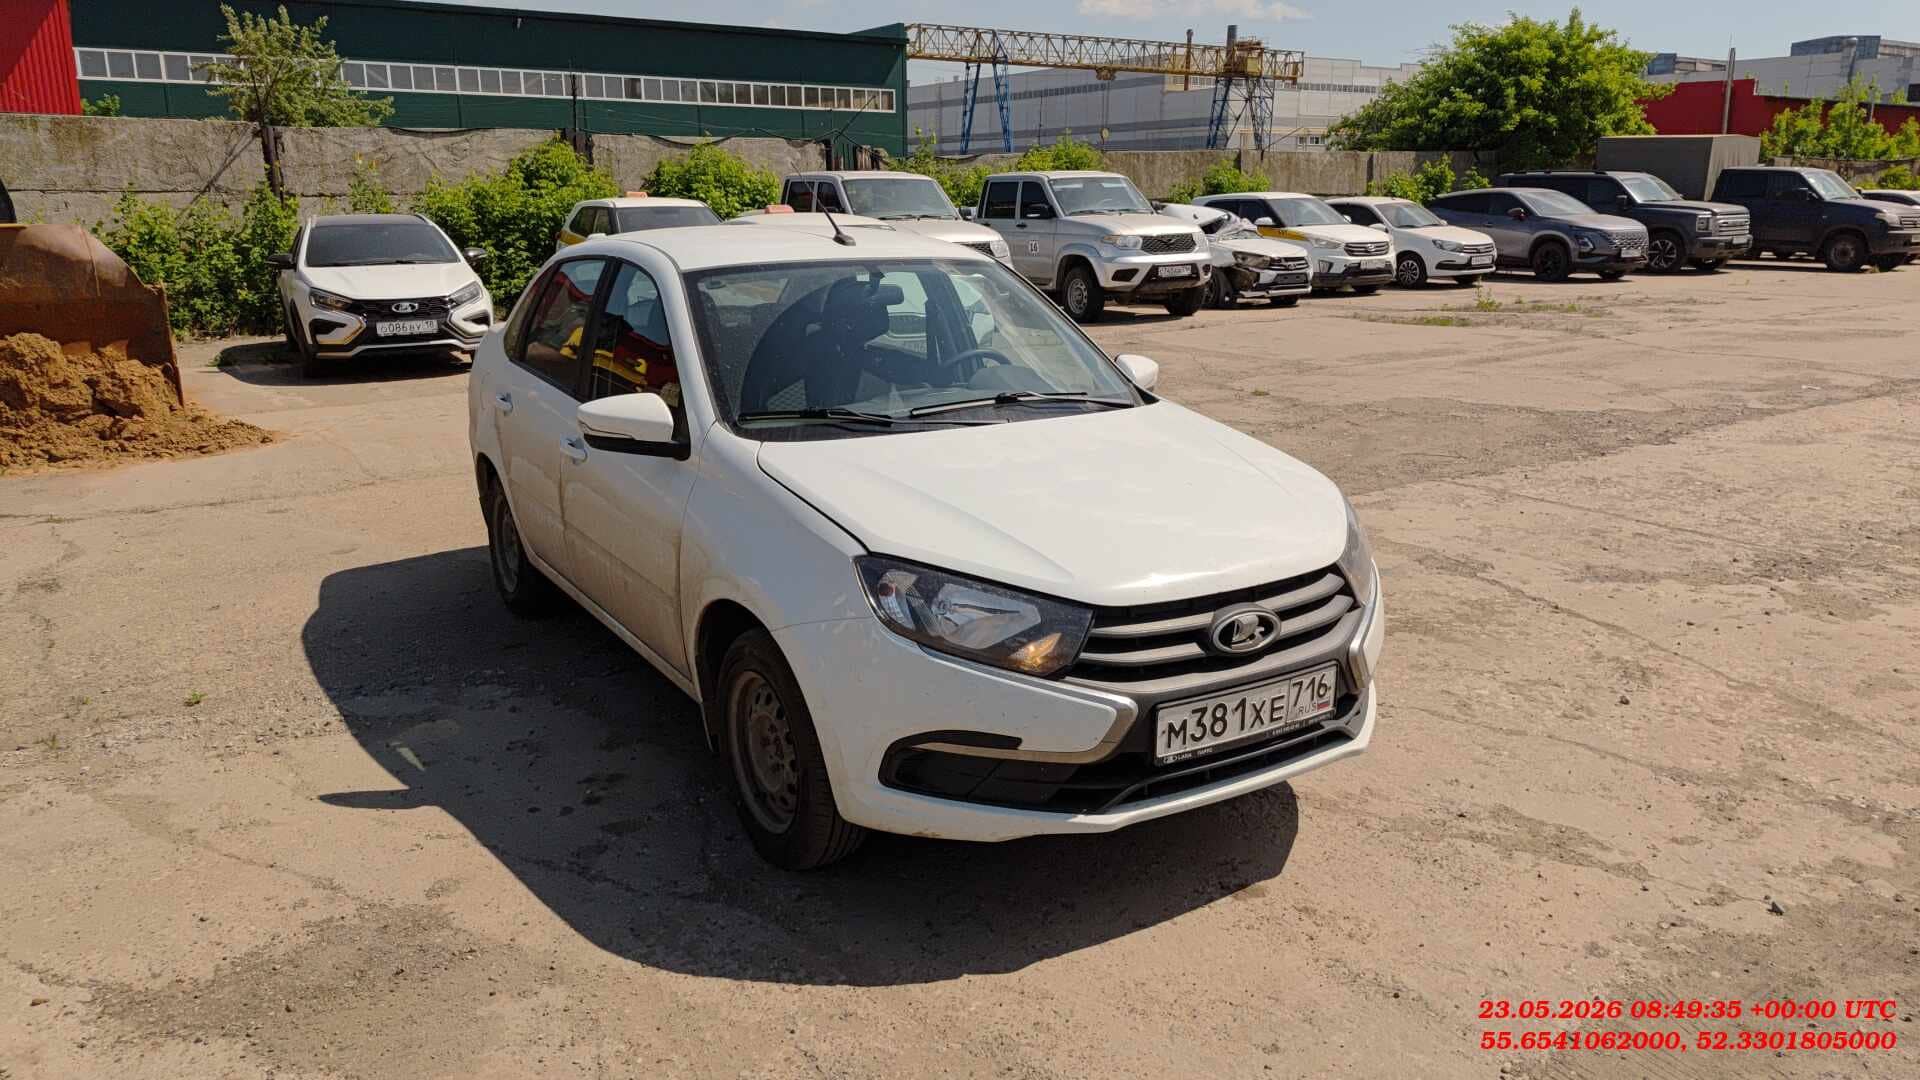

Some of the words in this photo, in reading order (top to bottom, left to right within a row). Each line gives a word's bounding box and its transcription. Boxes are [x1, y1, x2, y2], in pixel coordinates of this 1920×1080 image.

[1167, 694, 1285, 749] М381ХЕ
[1292, 673, 1328, 708] 716
[1297, 702, 1317, 716] RUS
